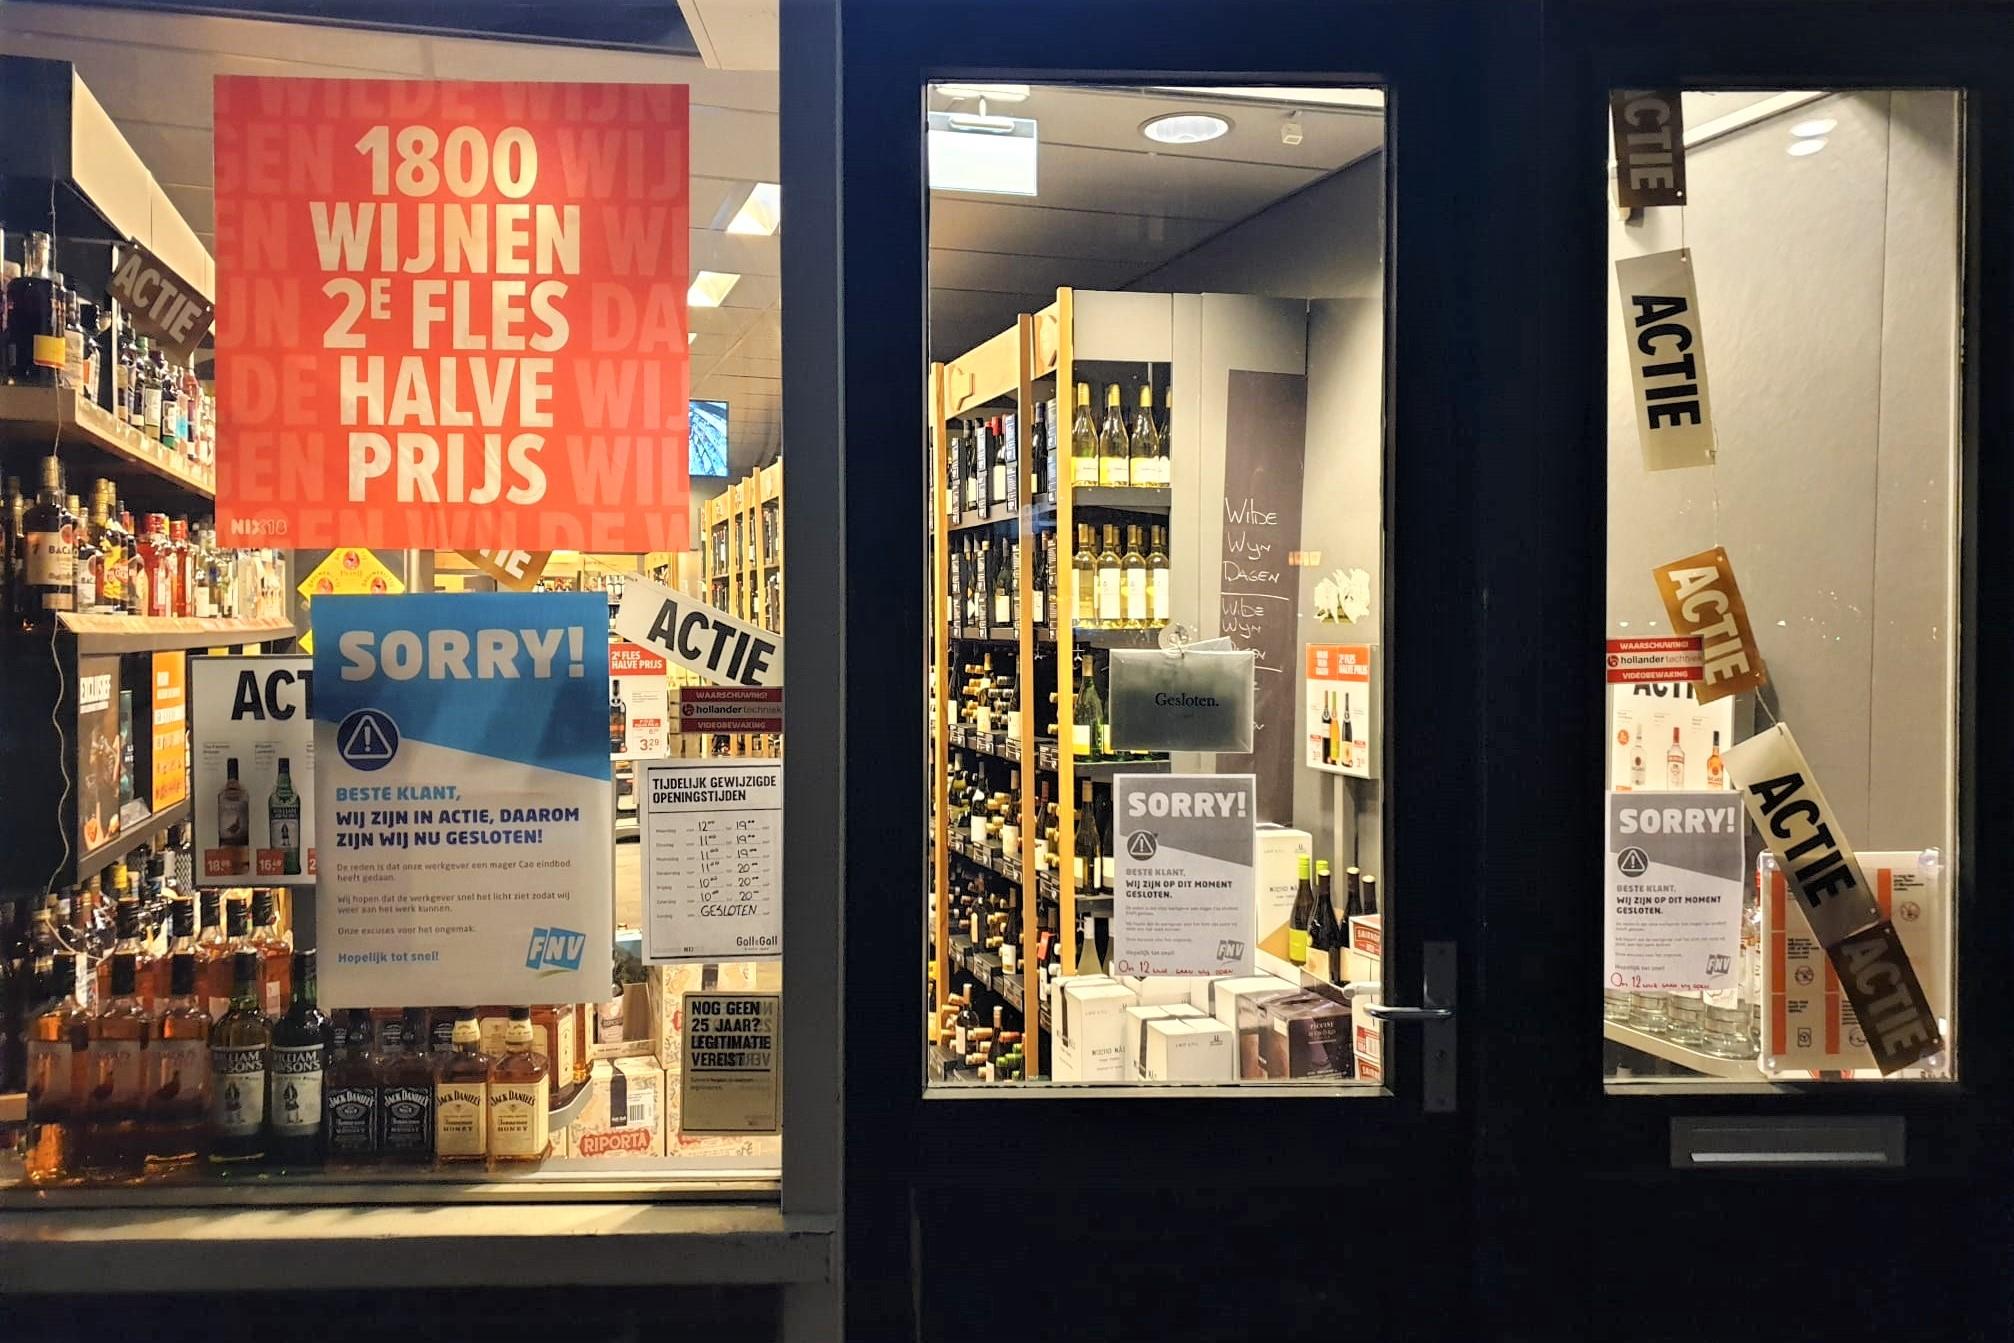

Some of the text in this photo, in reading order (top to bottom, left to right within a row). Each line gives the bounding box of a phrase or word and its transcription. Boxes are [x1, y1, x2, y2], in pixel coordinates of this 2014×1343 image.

[1623, 90, 1673, 191] CTIE
[353, 125, 539, 199] 1800
[308, 201, 581, 275] WIJNEN
[112, 253, 203, 344] ACTIE
[412, 280, 570, 352] FLES
[1631, 294, 1701, 430] ACTIE
[339, 355, 554, 427] HALVE
[348, 432, 548, 506] PRIJS
[1668, 565, 1751, 687] ACTIE
[646, 598, 777, 687] ACTIE
[338, 626, 585, 682] SORRY!
[621, 650, 641, 660] FLES
[1621, 655, 1665, 665] hollander
[611, 659, 663, 670] HALVE PRIJS
[695, 691, 768, 700] WAARSCHUWING!
[1154, 692, 1221, 708] Gesloten.
[696, 705, 743, 714] hollander
[697, 721, 766, 729] VIDEOBEWAKING
[652, 775, 777, 790] TIJDELIJK GEWIJZIGDE
[335, 784, 462, 803] BESTE KLANT,
[652, 789, 747, 804] OPENINGSTIJDEN
[1127, 791, 1247, 818] SORRY!
[335, 807, 580, 829] WIJ ZIJN IN ACTIE, DAAROM
[1619, 806, 1736, 834] SORRY!
[335, 828, 544, 850] ZIJN WIJ NU GESLOTEN!
[1749, 771, 1859, 907] ACTIE
[349, 862, 376, 872] reden
[386, 861, 401, 871] dat
[1125, 868, 1154, 877] BESTE
[336, 873, 361, 883] heeft
[1125, 880, 1234, 890] WIJ ZIJN OP DIT MOMENT
[1125, 890, 1174, 900] GESLOTEN.
[1654, 896, 1667, 904] OP
[1668, 896, 1683, 904] DIT
[1684, 896, 1722, 904] MOMENT
[700, 904, 758, 917] GESLOTEN
[337, 926, 360, 936] Onze
[528, 934, 585, 963] FNV
[1217, 942, 1245, 960] FNV
[337, 951, 440, 964] Hopelijk tot snel!
[1706, 955, 1732, 974] FNV
[1139, 960, 1150, 974] 12
[1631, 975, 1642, 988] 12
[1841, 937, 1929, 1056] ACTIE
[691, 1001, 761, 1016] NOG GEEN
[691, 1018, 761, 1033] 25 JAAR?
[690, 1034, 772, 1050] LEGITIMATIE
[691, 1051, 746, 1067] VEREIST
[490, 1093, 508, 1107] JACK
[583, 1131, 649, 1153] RIPORTA
